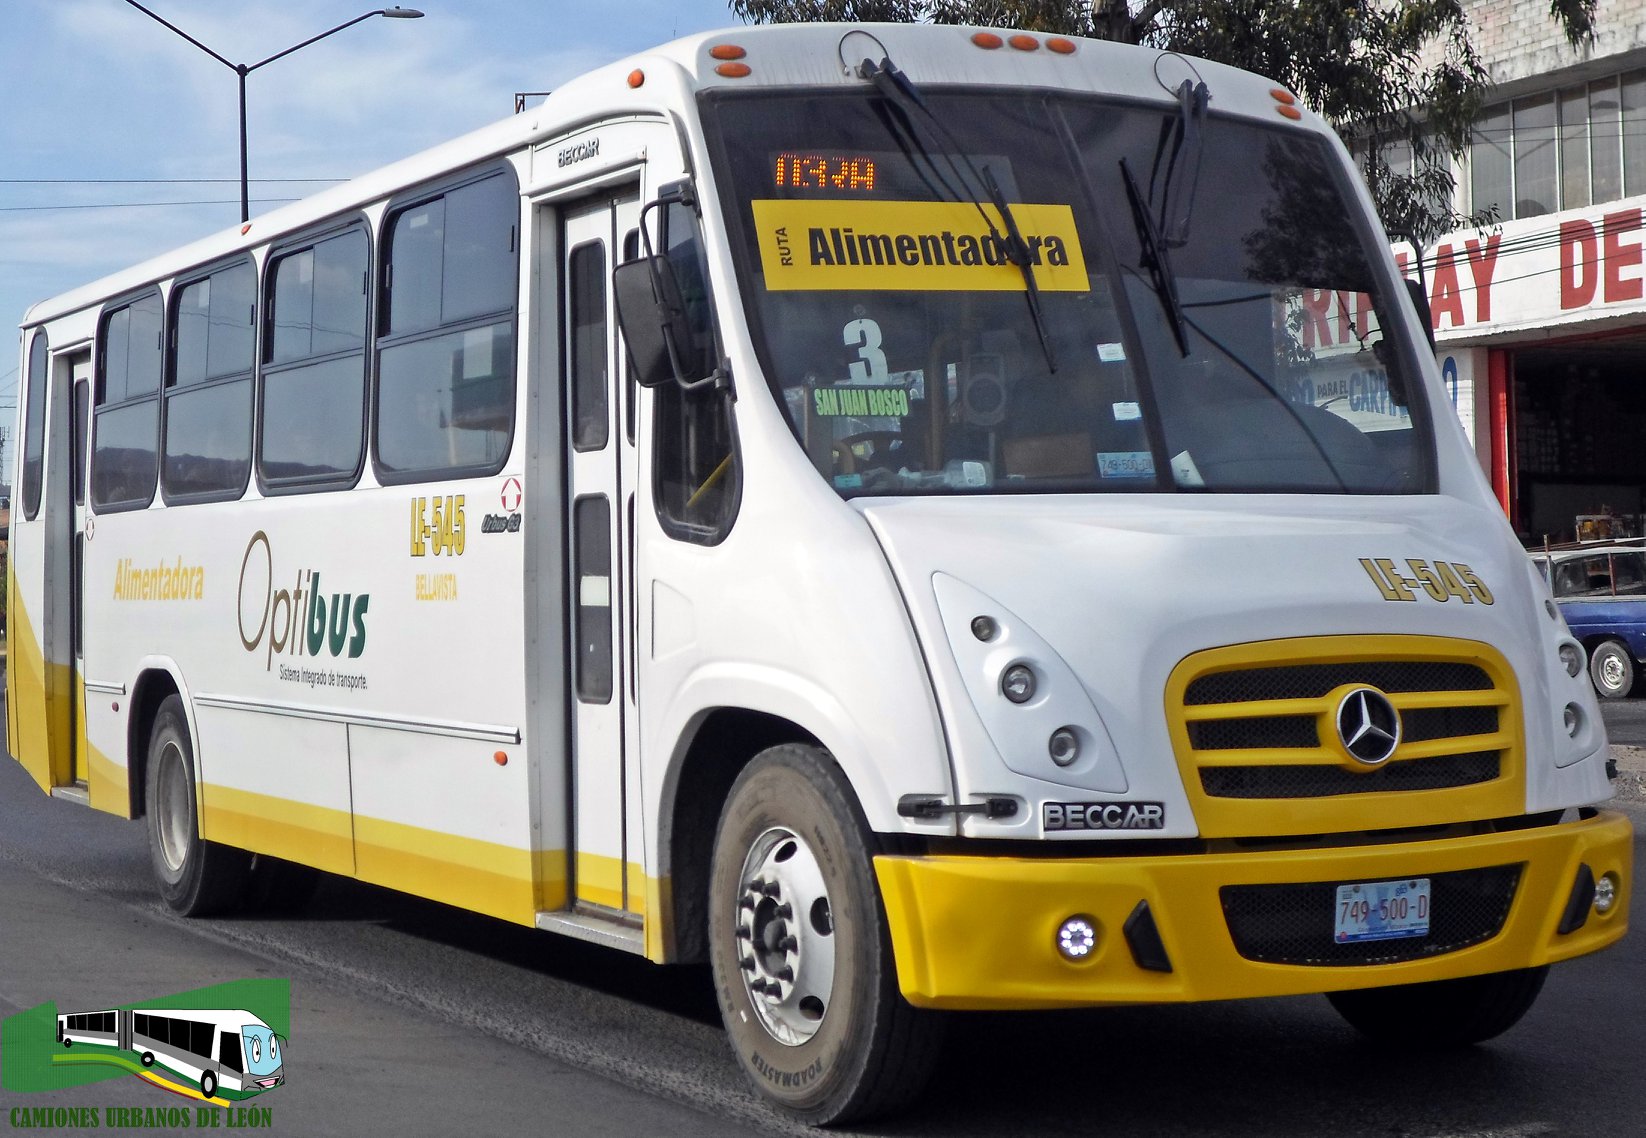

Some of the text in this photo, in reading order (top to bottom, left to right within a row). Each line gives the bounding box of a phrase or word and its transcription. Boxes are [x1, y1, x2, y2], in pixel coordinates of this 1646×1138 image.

[557, 138, 600, 168] BECCAR
[775, 227, 793, 266] RUTA
[1560, 208, 1643, 310] DE
[843, 318, 888, 385] 3
[814, 389, 909, 416] SAN JUAN BOSCO
[1317, 382, 1338, 398] PARA
[1339, 380, 1349, 395] EL
[410, 494, 466, 557] LE-545
[481, 514, 508, 534] Urbus
[113, 556, 204, 600] Alimentadora
[416, 573, 459, 600] BELLAVISTA
[1358, 558, 1495, 606] LE-545
[237, 530, 370, 671] Optibus
[279, 663, 300, 683] Sistema
[301, 666, 327, 689] Integrado
[328, 672, 336, 687] de
[1043, 804, 1164, 830] BECCAR
[1340, 895, 1428, 925] 749-500-D
[751, 1050, 822, 1087] ROADMASTER
